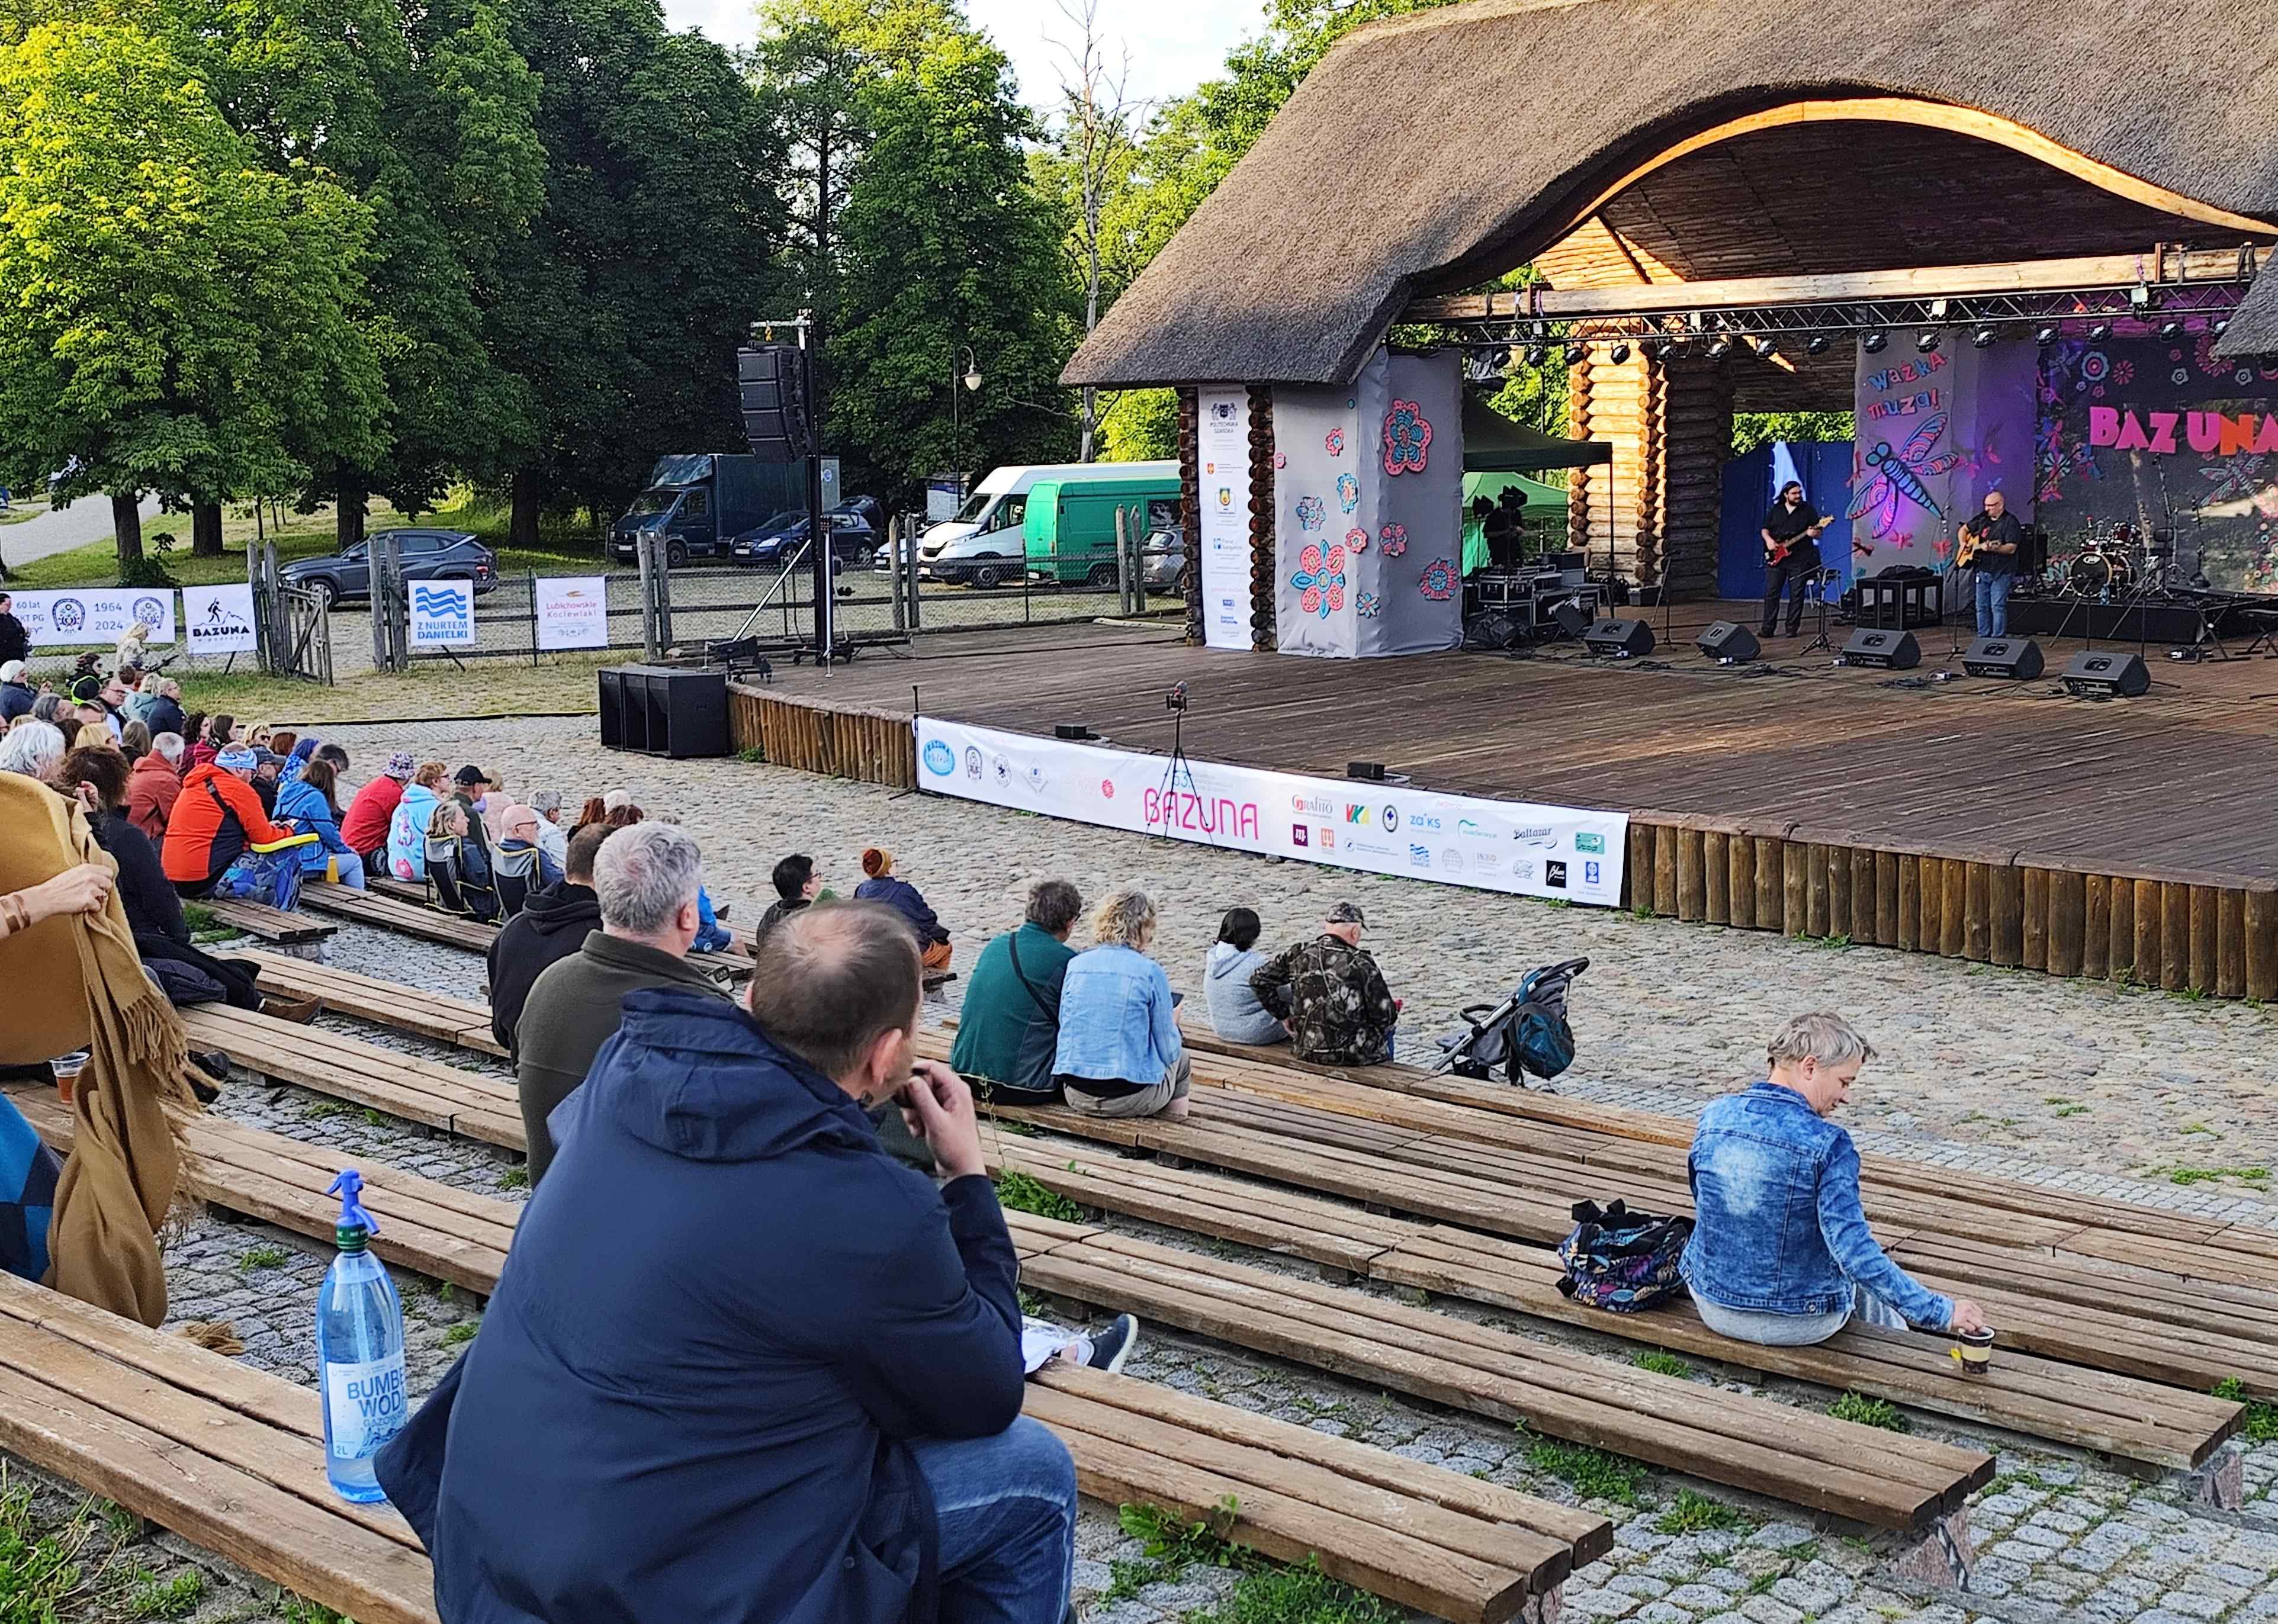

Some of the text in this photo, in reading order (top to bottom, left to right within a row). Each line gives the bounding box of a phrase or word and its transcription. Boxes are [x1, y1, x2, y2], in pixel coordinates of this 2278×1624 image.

[29, 600, 40, 609] lat
[95, 602, 122, 612] 1964
[95, 620, 123, 631] 2024
[417, 620, 468, 630] Z NURTEM
[192, 626, 249, 636] BAZUNA
[417, 631, 468, 639] DANIELKI
[1143, 787, 1259, 840] BAZUNA
